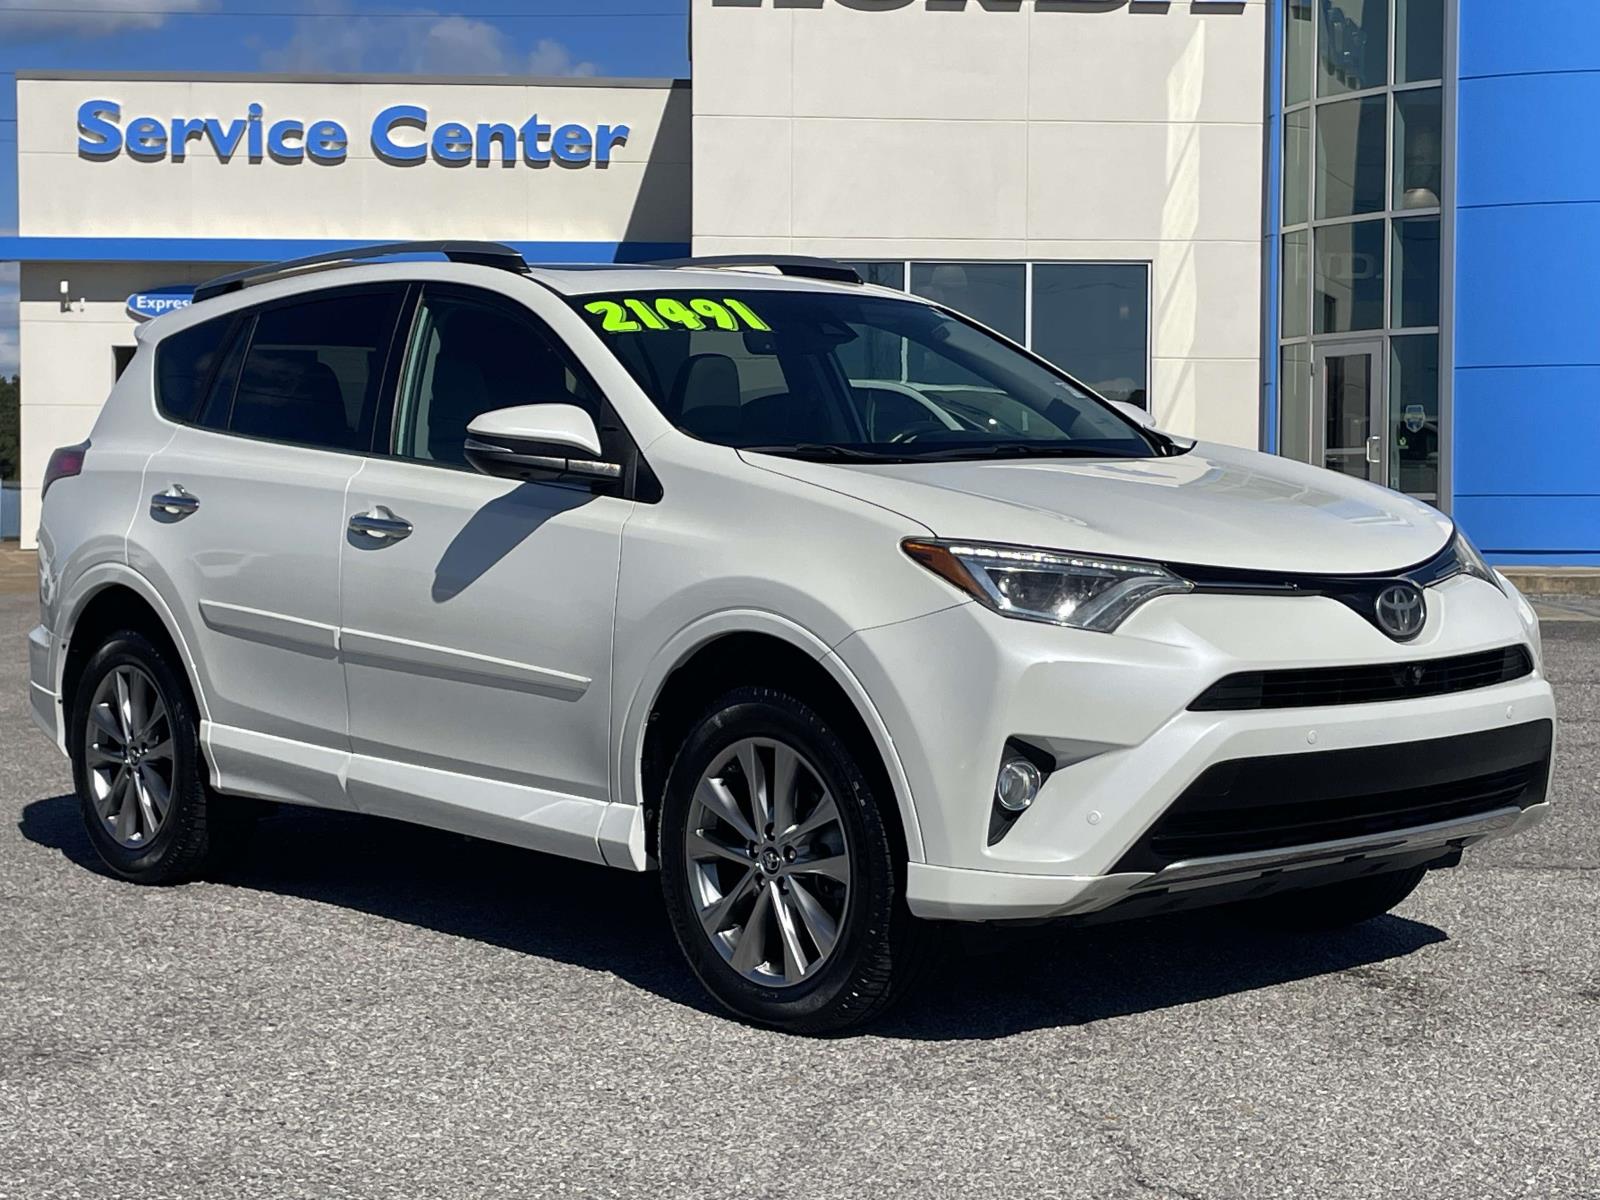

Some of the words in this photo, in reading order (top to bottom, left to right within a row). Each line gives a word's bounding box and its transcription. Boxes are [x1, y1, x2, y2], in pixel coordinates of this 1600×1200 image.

[77, 100, 346, 162] Service
[371, 104, 630, 167] Center
[136, 295, 192, 312] Expres
[584, 298, 772, 332] 21491
